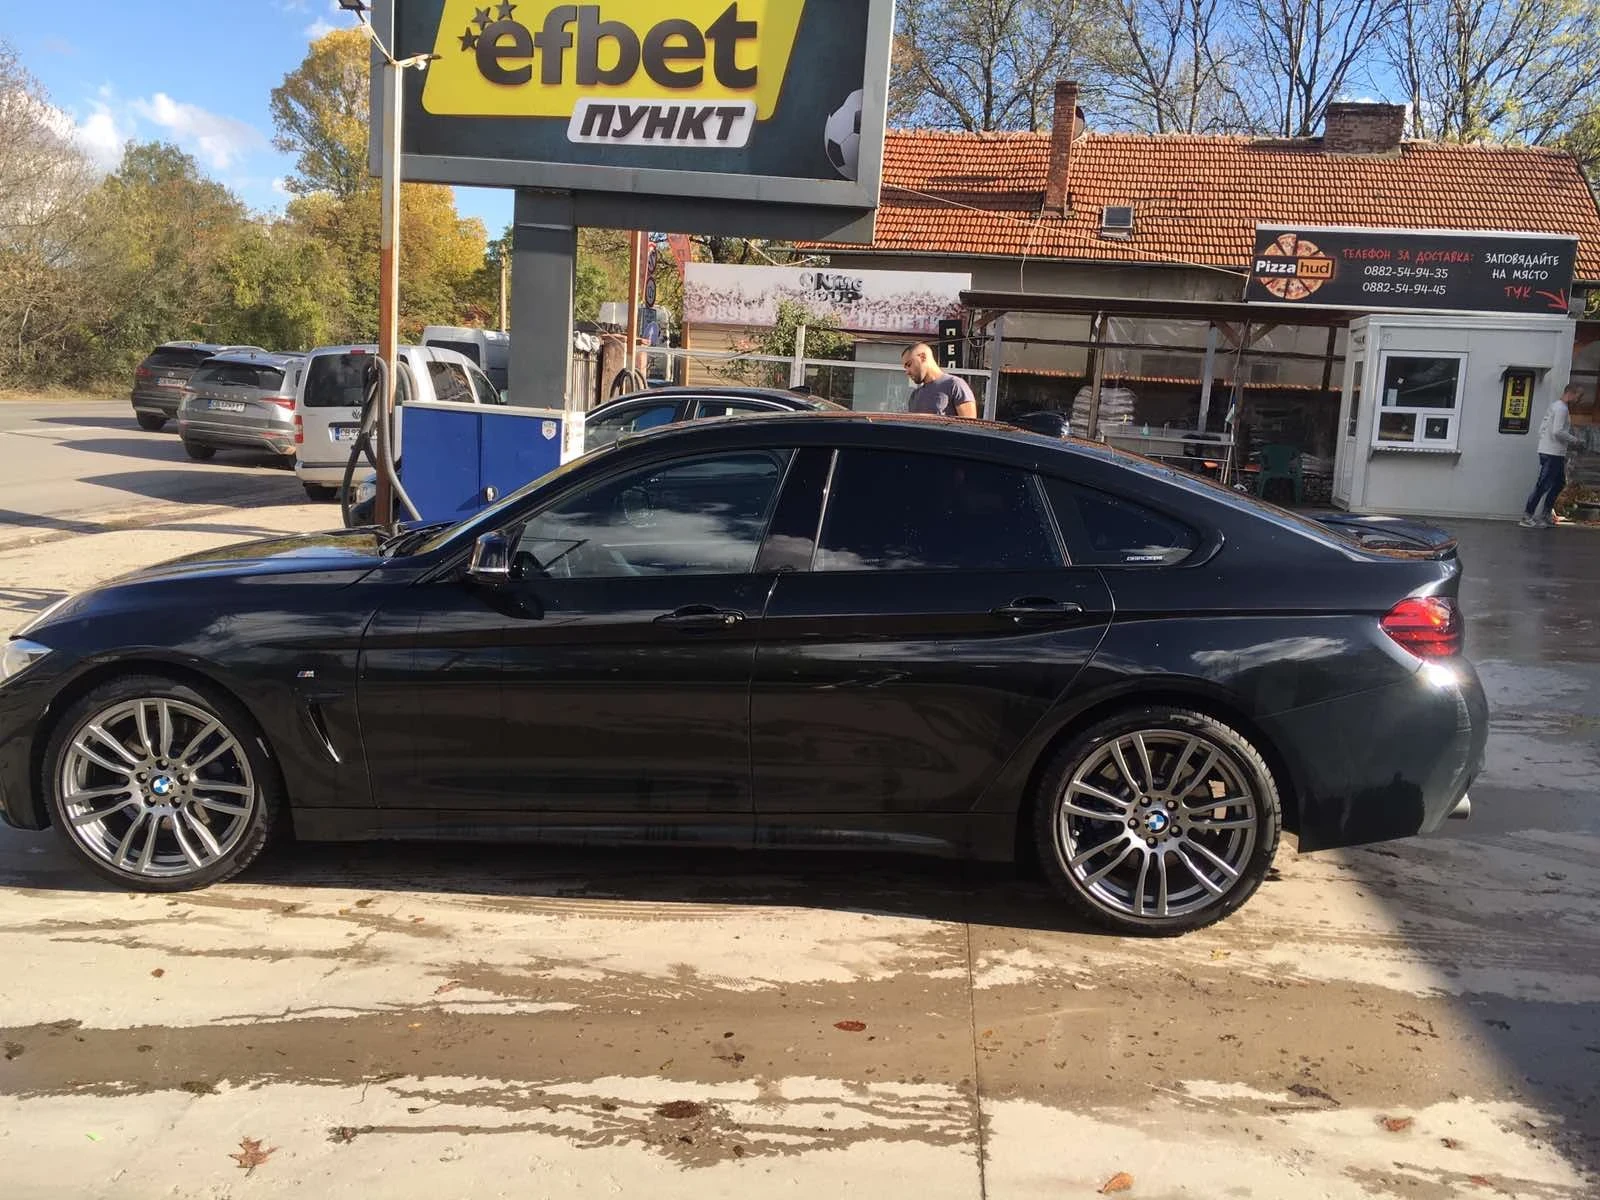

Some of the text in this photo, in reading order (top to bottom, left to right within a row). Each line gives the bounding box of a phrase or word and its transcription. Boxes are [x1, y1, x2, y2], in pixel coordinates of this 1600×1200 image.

[475, 1, 757, 89] efbet
[579, 103, 746, 141] ПУНКТ
[1342, 248, 1391, 259] ТЕЛЕФОН
[1396, 250, 1410, 260] ЗА
[1484, 252, 1560, 268] ЗАПОВЯДАЙТЕ
[1255, 260, 1330, 274] Pizza hud
[1364, 265, 1449, 279] 0882-54-94-35
[1492, 268, 1549, 280] НА МЯСТО
[1362, 281, 1447, 295] 0882-54-94-45
[1504, 285, 1532, 299] ТУК
